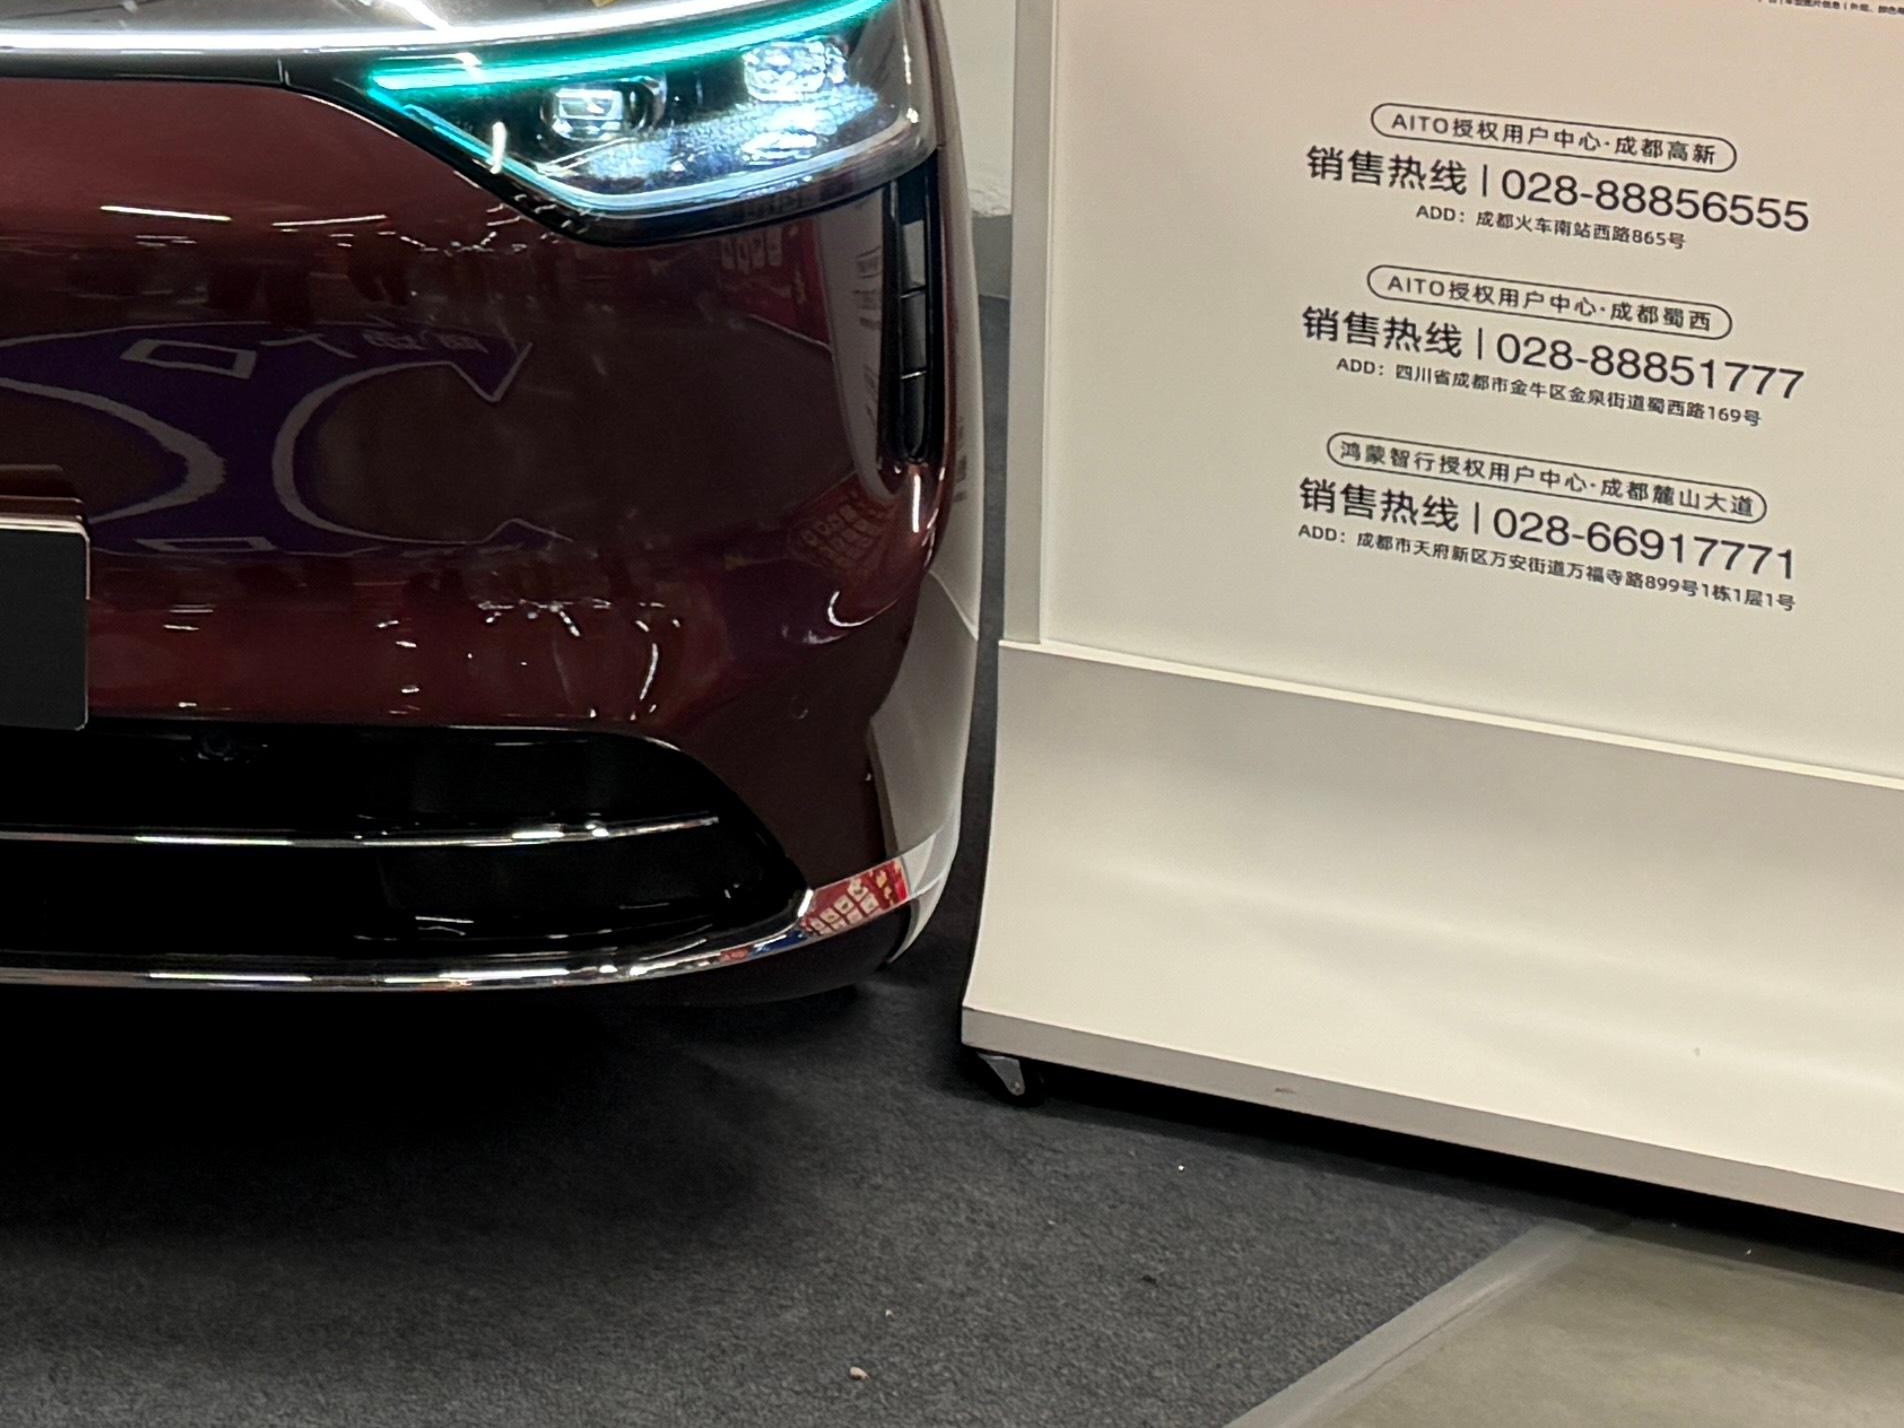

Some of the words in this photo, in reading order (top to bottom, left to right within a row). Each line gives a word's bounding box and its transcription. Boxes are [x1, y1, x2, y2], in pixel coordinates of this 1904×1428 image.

[1391, 112, 1717, 165] AITO授权用户中心·成都高新
[1305, 144, 1468, 195] 销售热线
[1501, 168, 1810, 232] 028-88856555
[1475, 210, 1687, 250] 成都火车南站西路865号
[1387, 275, 1712, 332] AITO授权用户中心·成都蜀西
[1301, 304, 1463, 359] 销售热线
[1496, 332, 1805, 400] 028-88851777
[1395, 363, 1762, 427] 四川省成都市金牛区金泉街道蜀西路169号
[1339, 439, 1756, 517] 鸿蒙智行授权用户中心·成都麓山大道
[1298, 475, 1460, 532] 销售热线
[1493, 507, 1795, 580] 028-66917771
